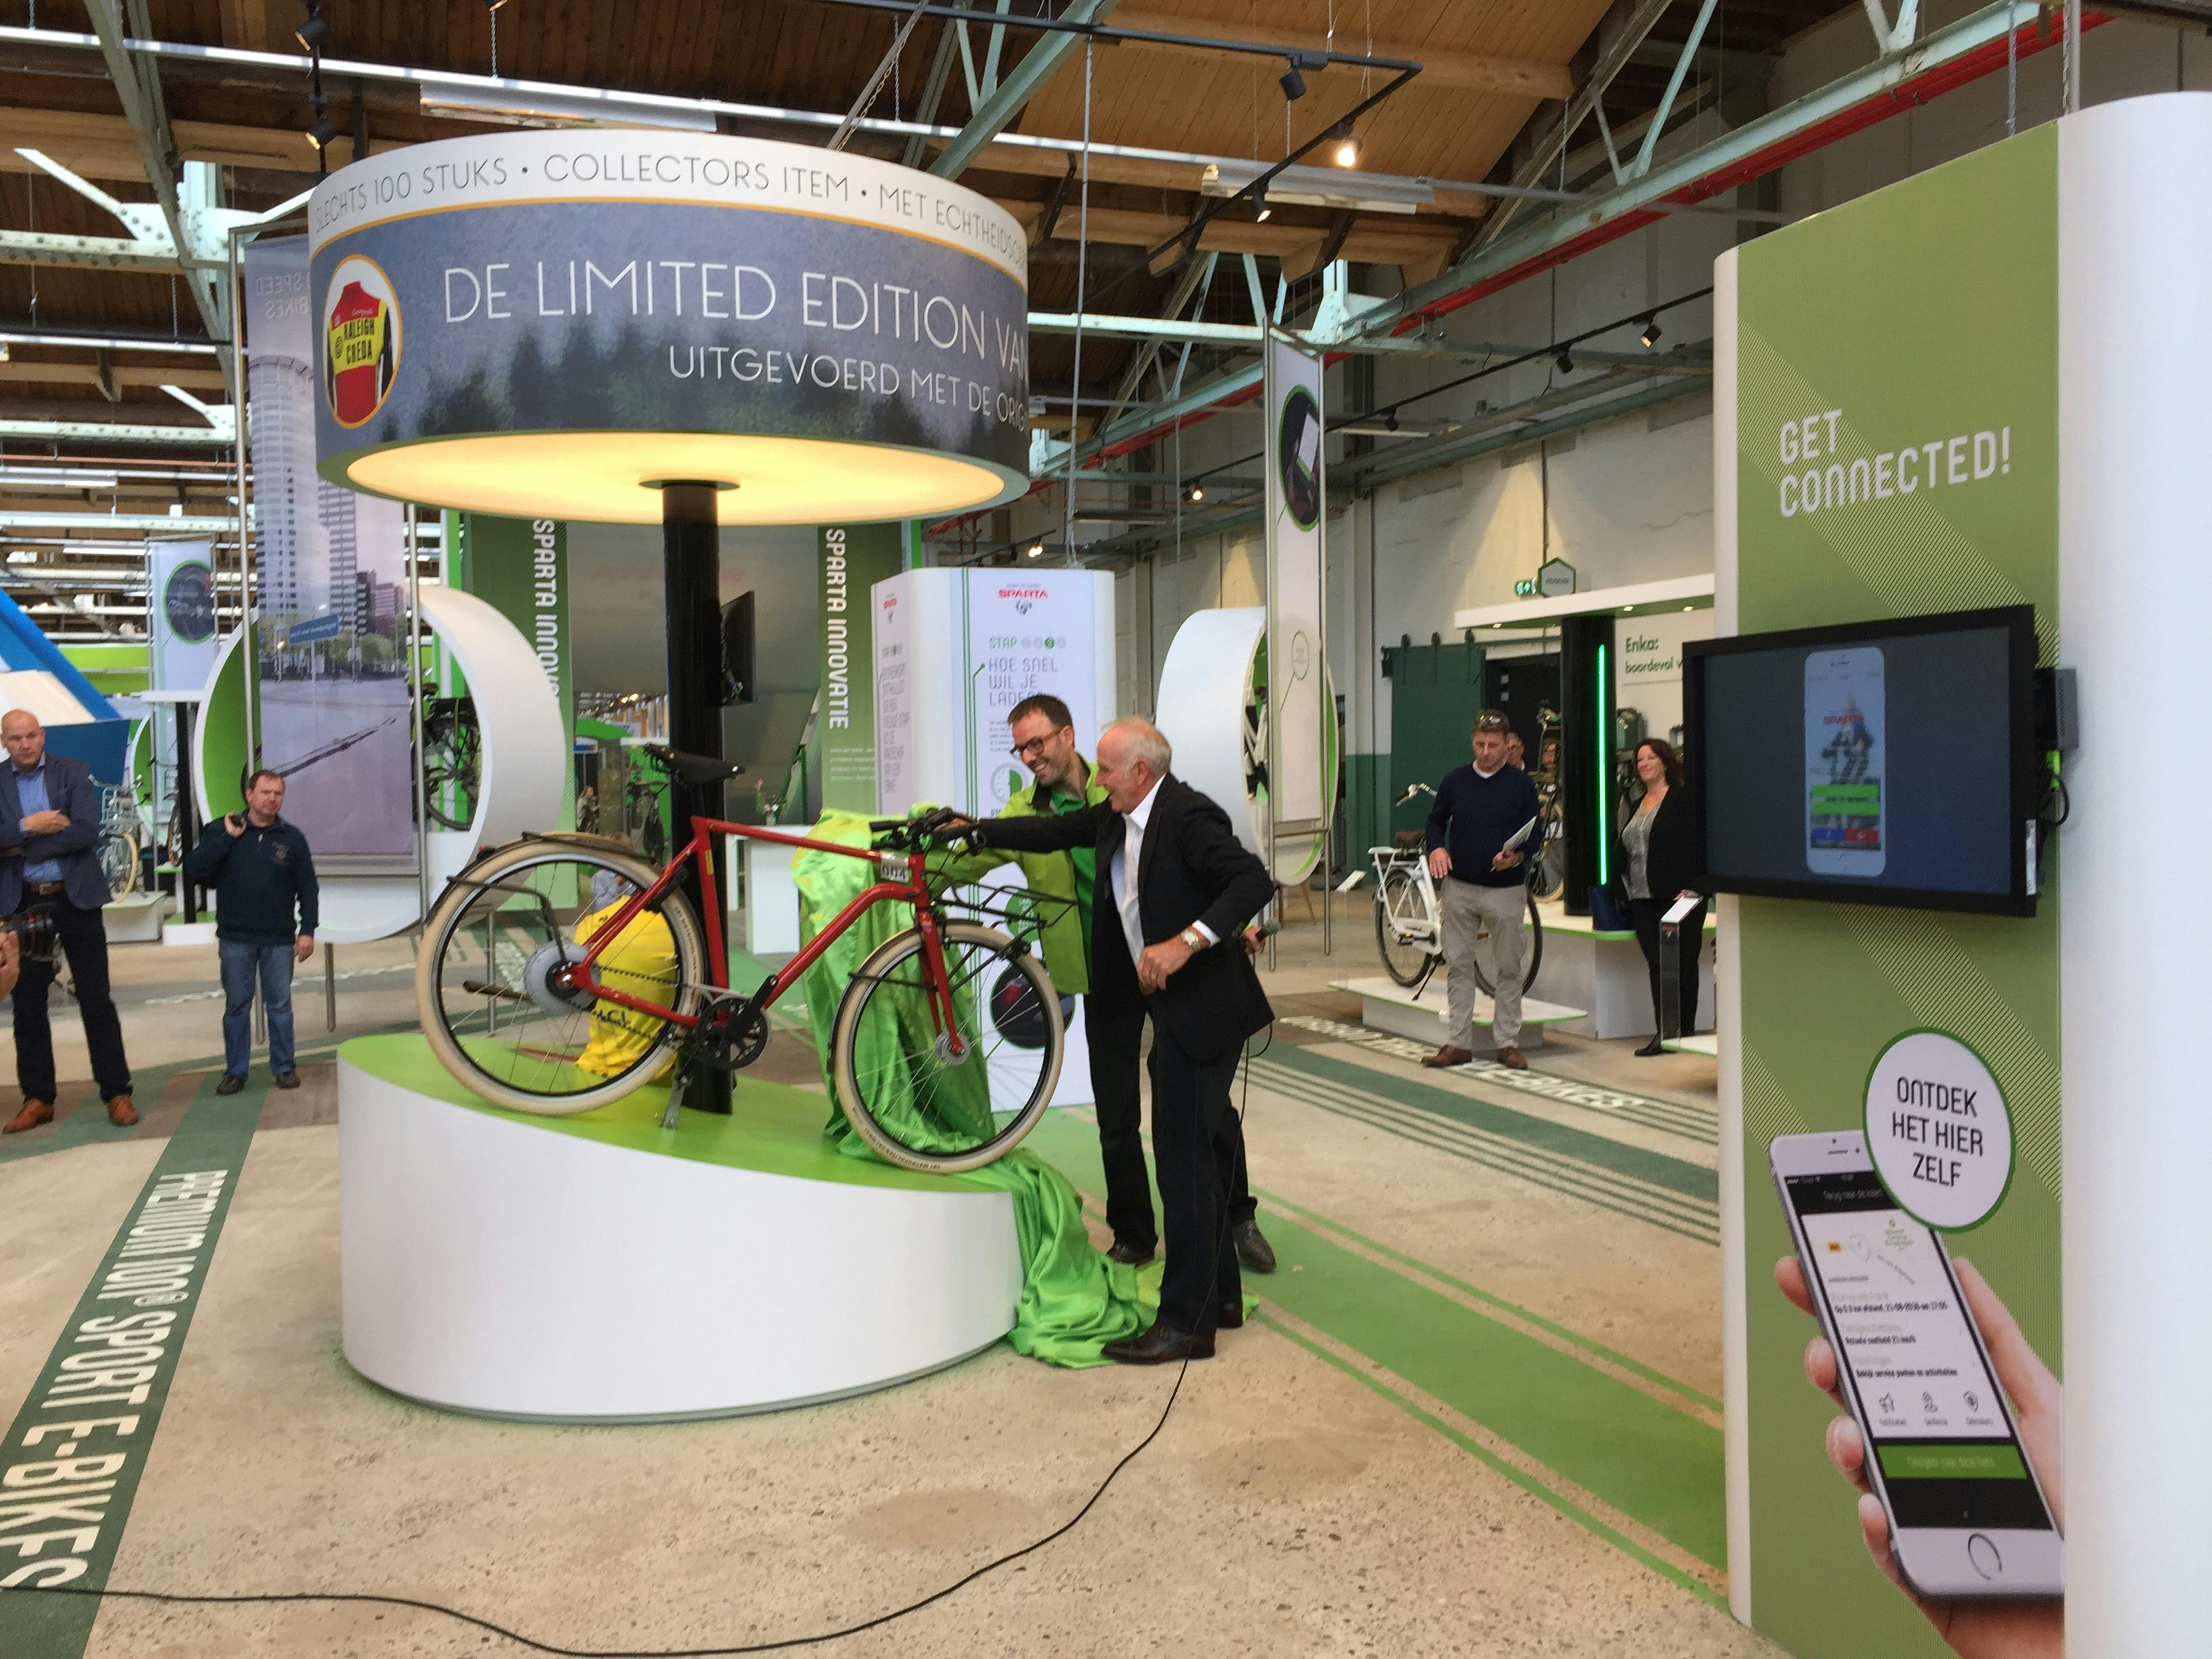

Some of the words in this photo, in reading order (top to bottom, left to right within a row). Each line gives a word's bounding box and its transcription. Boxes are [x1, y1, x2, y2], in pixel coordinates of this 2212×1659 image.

[374, 172, 411, 205] 100
[422, 158, 508, 196] STUKS
[544, 153, 770, 190] COLLECTORS
[783, 166, 848, 202] ITEM
[879, 184, 927, 220] MET
[445, 263, 512, 323] DE
[537, 260, 777, 322] LIMITED
[802, 271, 985, 360] EDITION
[669, 345, 900, 396] UITGEVOERD
[911, 369, 961, 407] MET
[968, 381, 991, 417] DE
[1779, 408, 1842, 464] GET
[1779, 426, 2010, 517] CONNECTED!
[533, 519, 557, 607] SPARTA
[825, 528, 847, 613] SPARTA
[998, 590, 1048, 598] SPARTA
[989, 636, 1017, 649] STAP
[989, 657, 1017, 673] HOE
[1022, 657, 1059, 673] SNEL
[1625, 634, 1659, 653] Enka:
[1625, 655, 1674, 674] boordevol
[827, 618, 848, 730] INNOVATIE
[989, 674, 1015, 690] WIL
[1021, 674, 1038, 690] JE
[1898, 1076, 1978, 1118] ONTDEK
[1893, 1111, 1930, 1144] HET
[1936, 1120, 1983, 1157] HIER
[1913, 1151, 1962, 1187] ZELF
[41, 1311, 178, 1410] SPORT
[0, 1414, 140, 1589] E-BIKES
